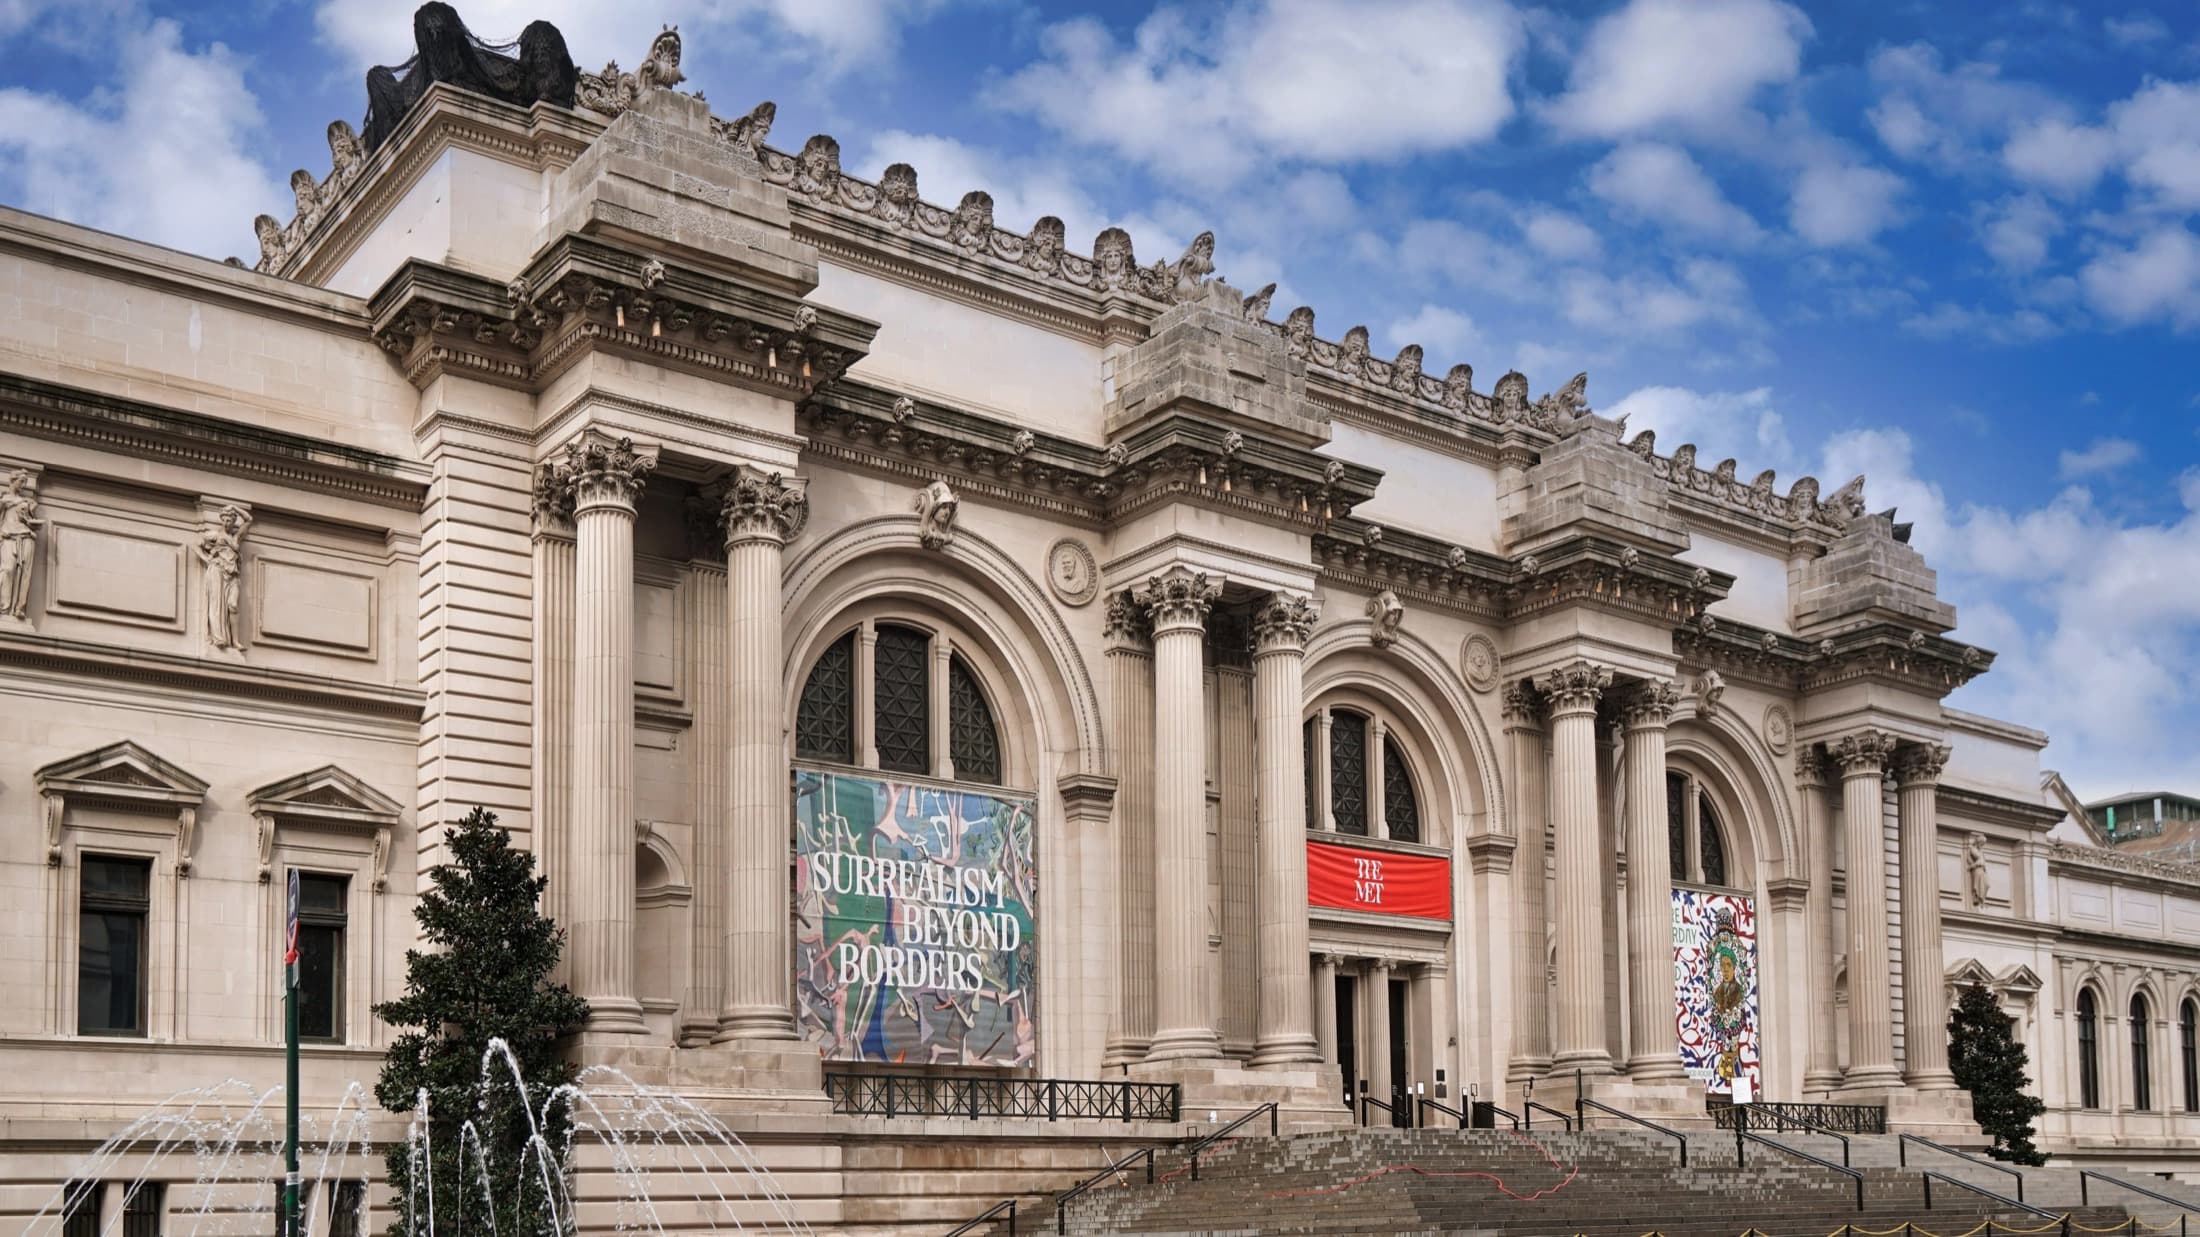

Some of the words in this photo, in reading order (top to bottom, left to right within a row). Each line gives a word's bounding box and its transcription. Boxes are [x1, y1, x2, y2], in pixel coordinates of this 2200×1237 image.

[812, 851, 1005, 909] SURREALISM
[1354, 858, 1384, 881] THE
[1354, 880, 1384, 904] MET
[902, 903, 1020, 951] BEYOND
[838, 943, 983, 992] BORDERS
